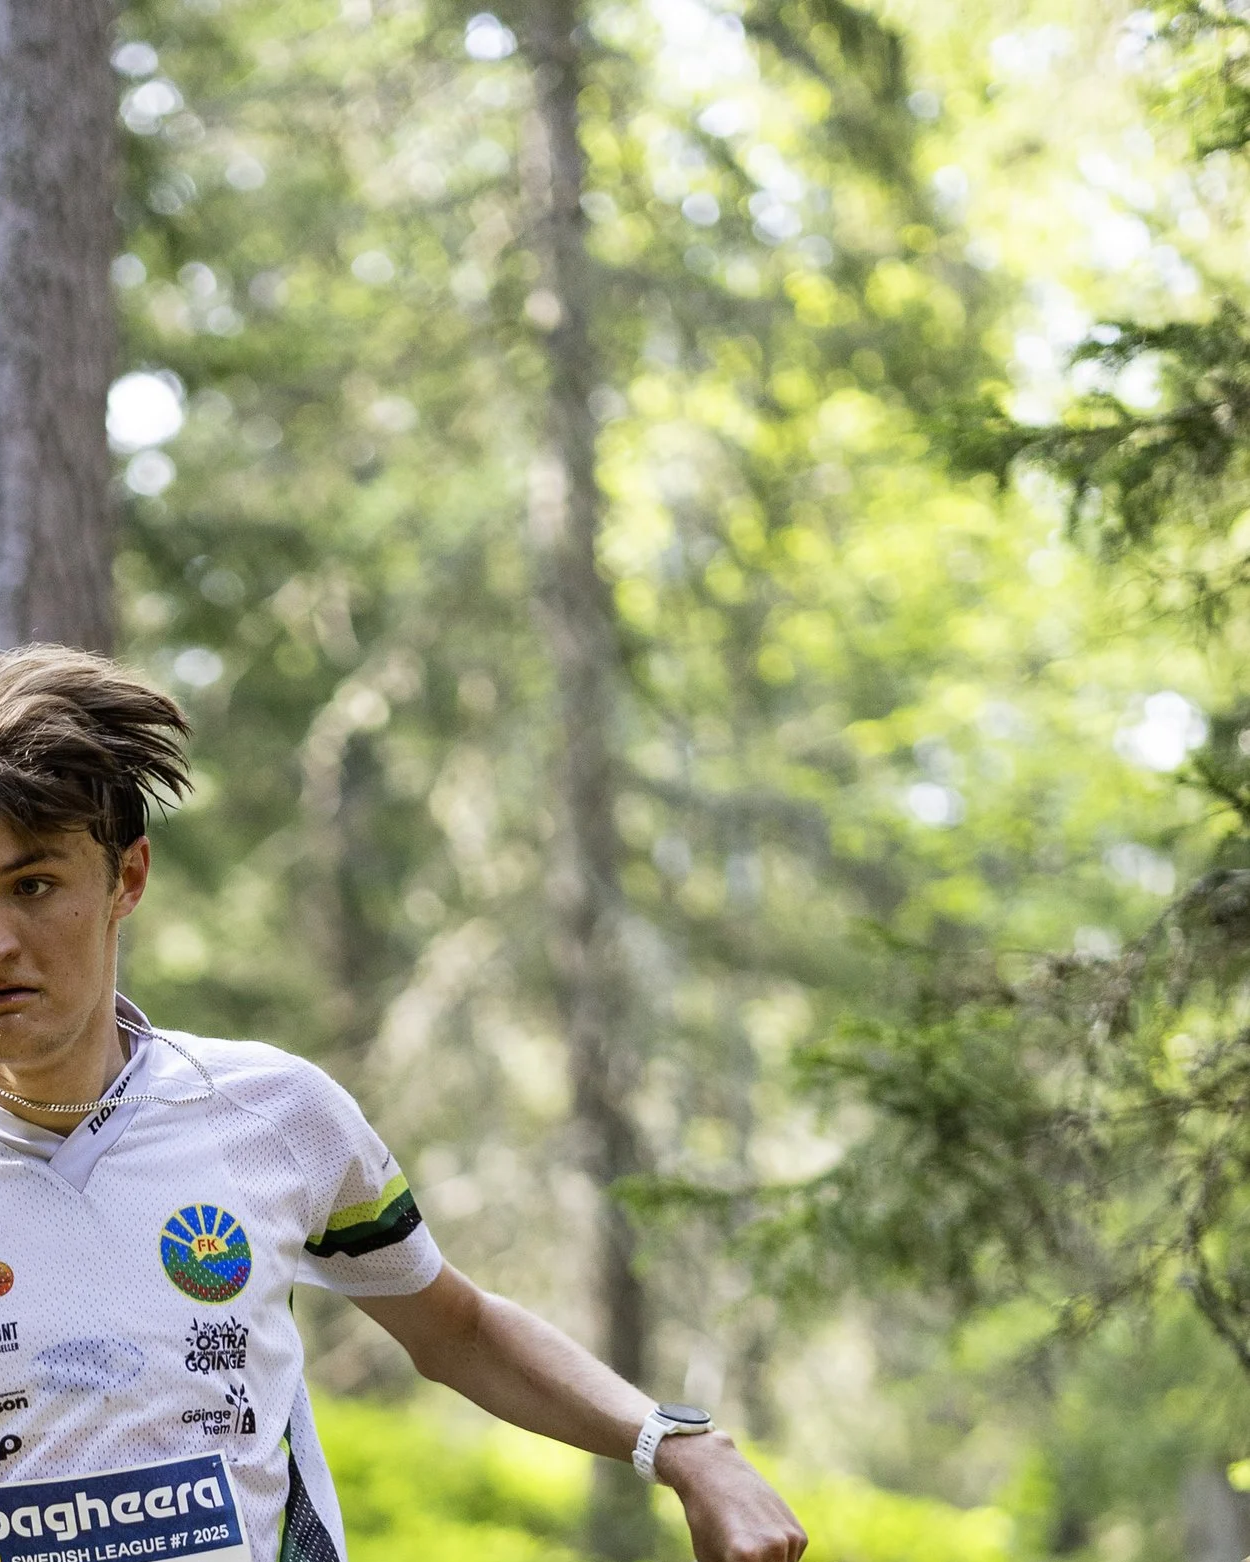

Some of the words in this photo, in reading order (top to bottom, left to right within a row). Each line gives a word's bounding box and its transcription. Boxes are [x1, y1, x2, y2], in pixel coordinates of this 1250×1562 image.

[197, 1238, 219, 1252] FK
[181, 1408, 231, 1424] Göinge
[202, 1421, 231, 1435] hem
[95, 1535, 167, 1561] LEAGUE
[170, 1530, 188, 1549] #7
[193, 1524, 230, 1545] 2025
